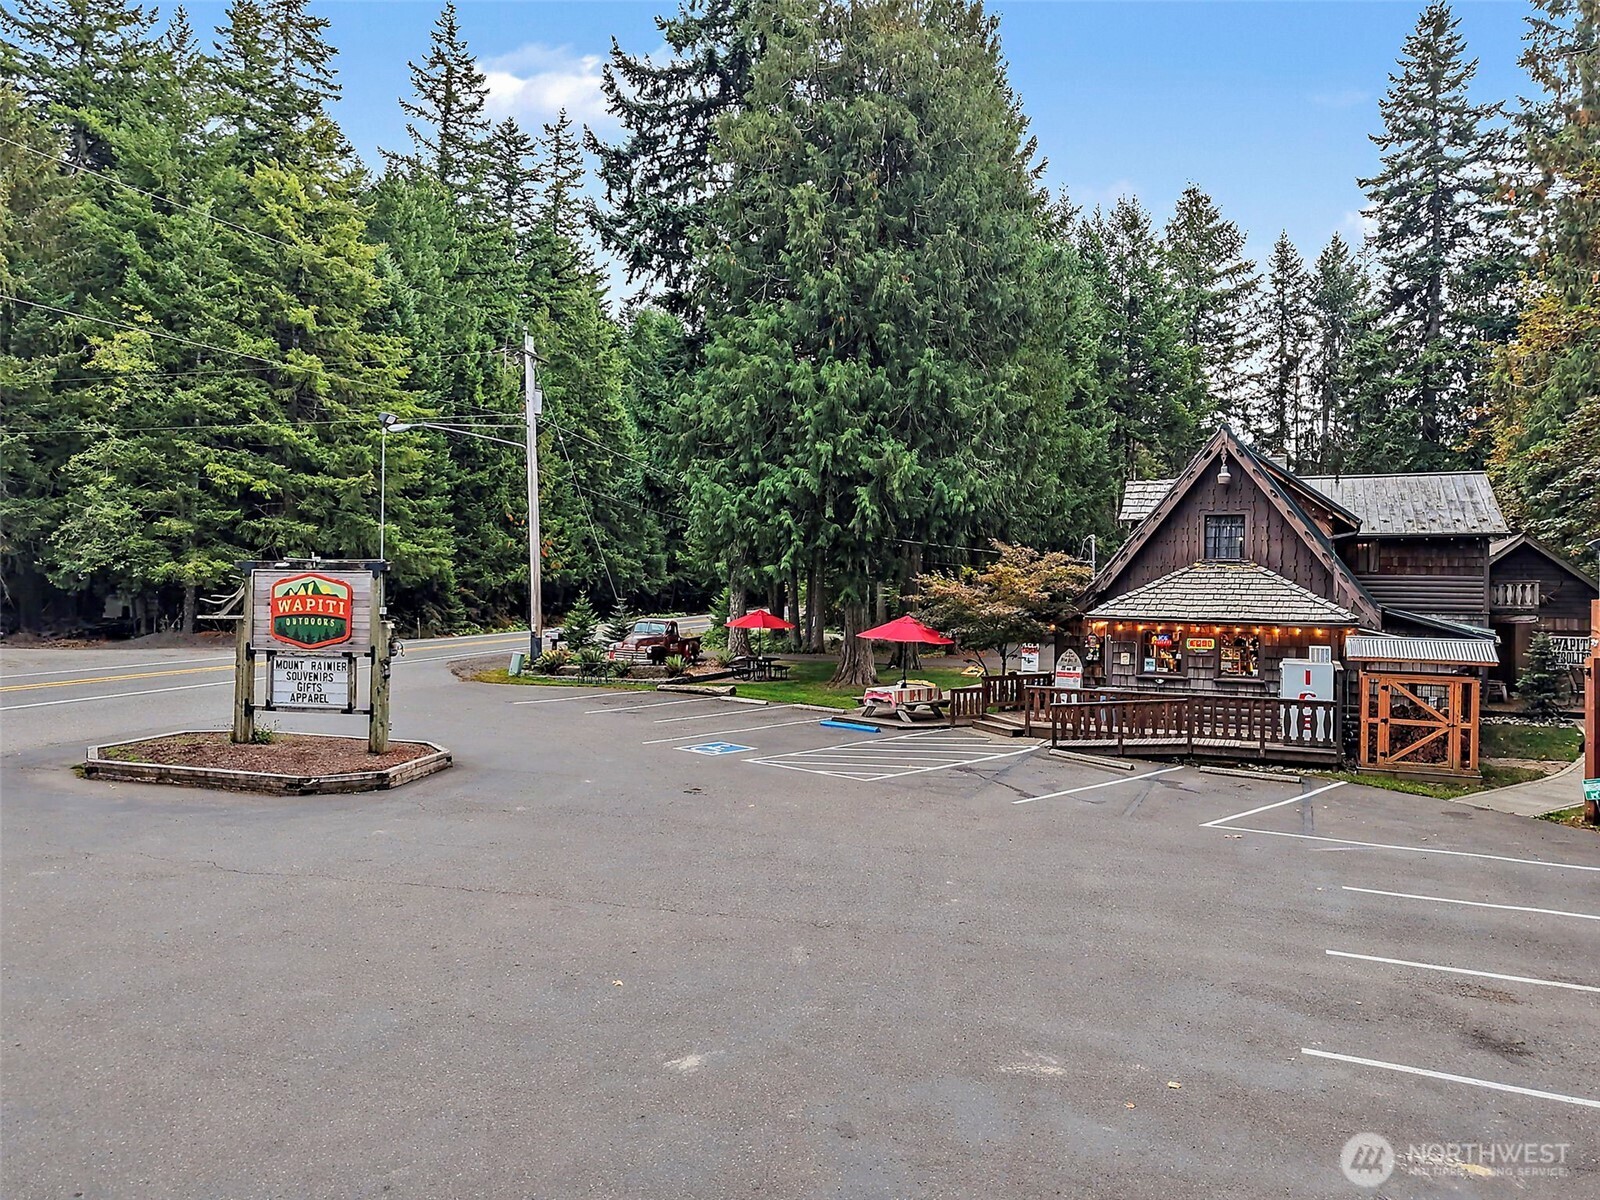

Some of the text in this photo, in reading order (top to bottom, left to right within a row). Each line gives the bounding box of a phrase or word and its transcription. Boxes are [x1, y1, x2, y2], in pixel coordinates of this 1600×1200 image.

[277, 598, 345, 615] WAPITI
[285, 618, 335, 627] OUTDOORS
[275, 660, 347, 671] MOUNT RAINIER
[286, 671, 334, 682] SOUVENIRS
[297, 682, 322, 692] GIFTS
[290, 693, 329, 703] APPAREL
